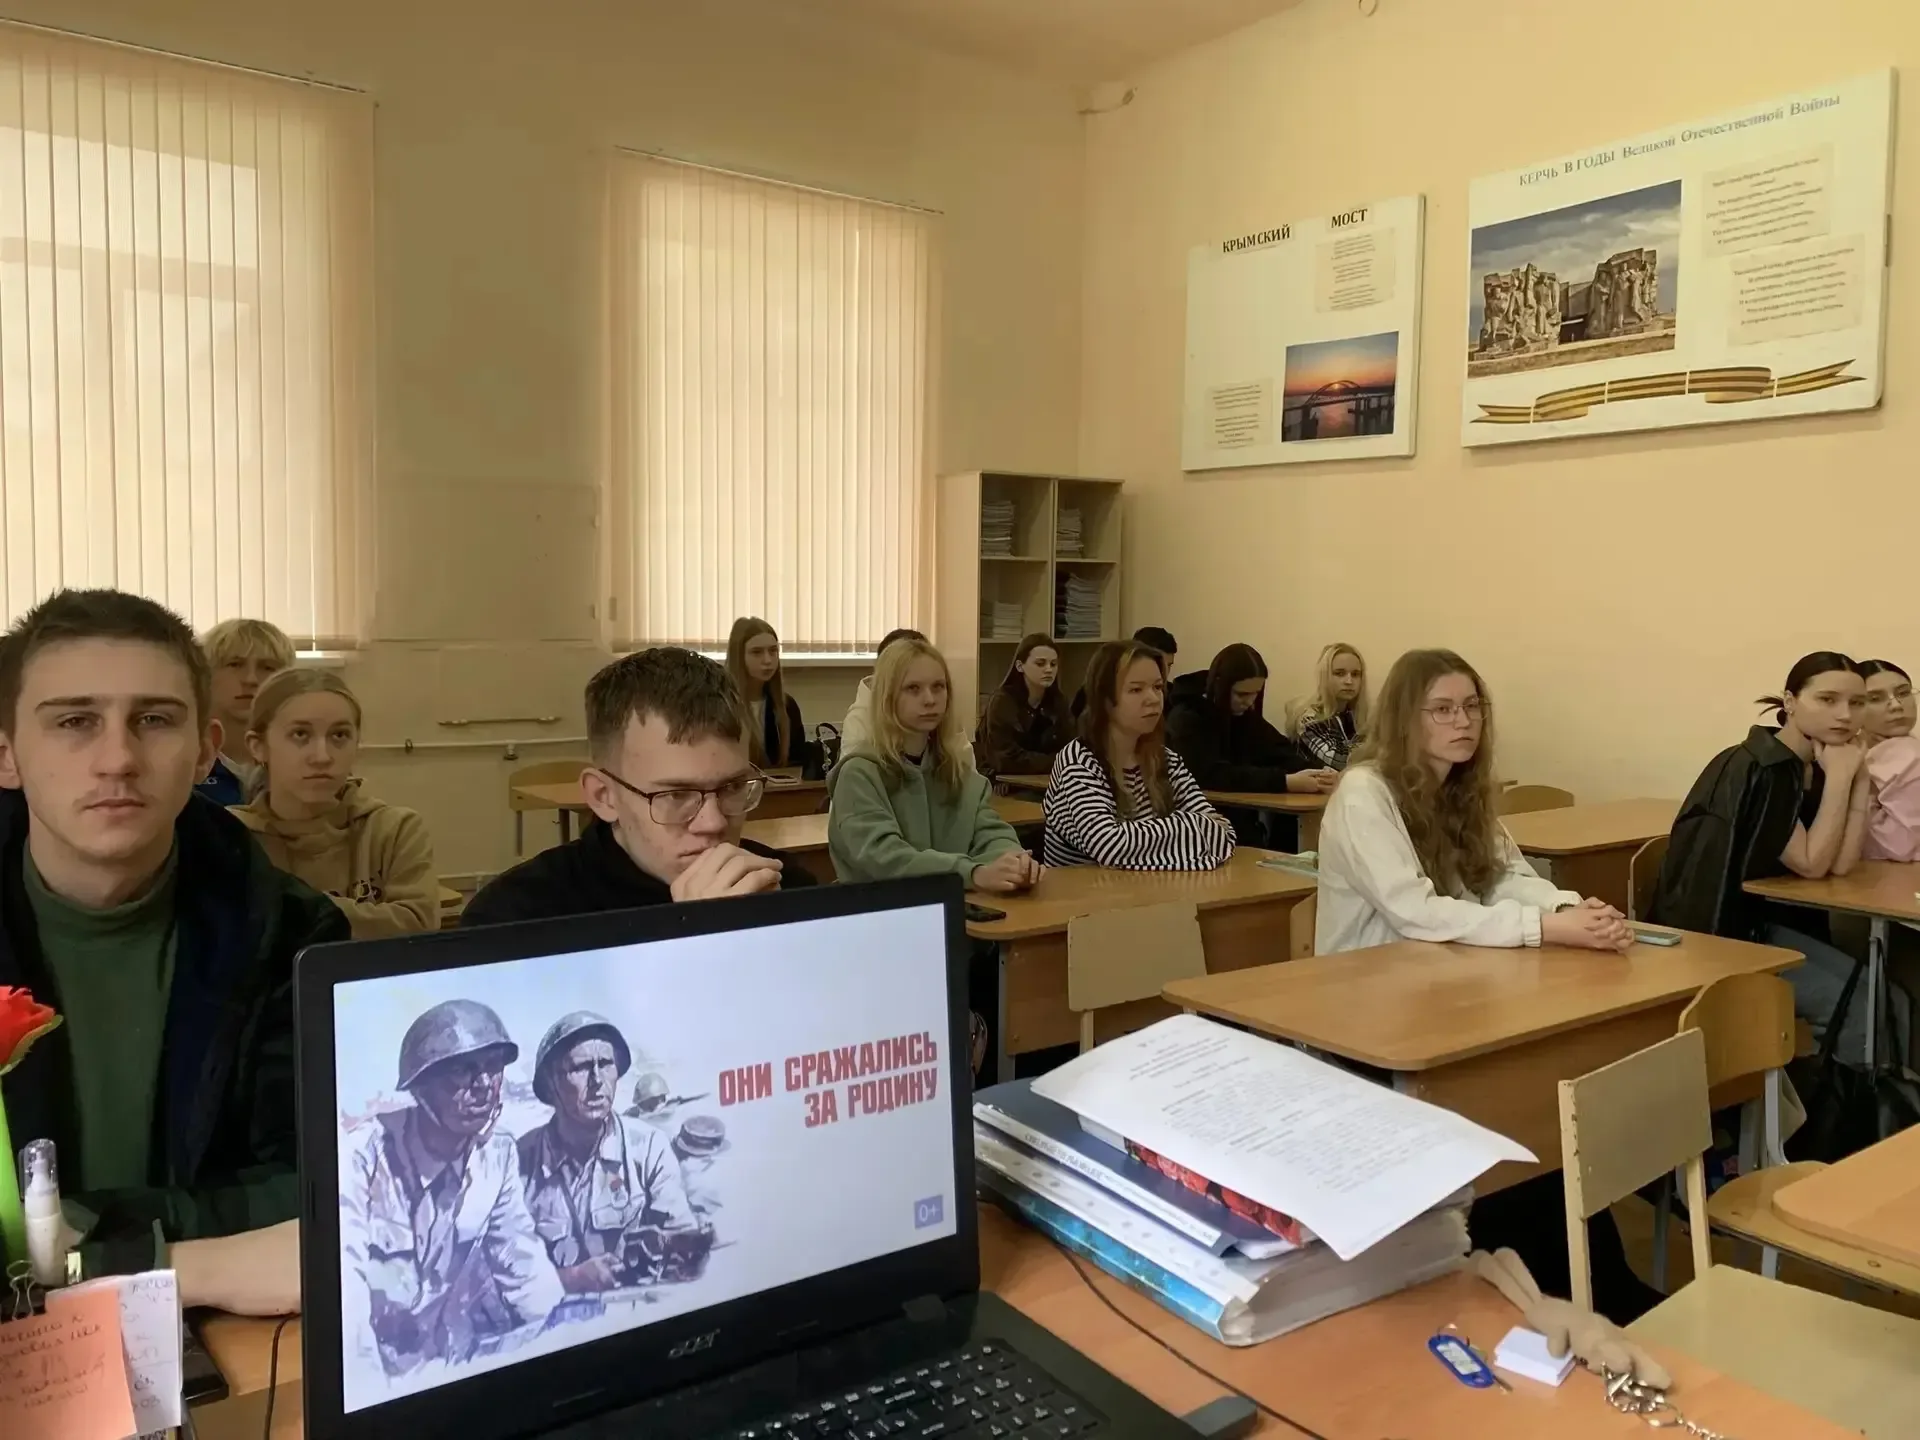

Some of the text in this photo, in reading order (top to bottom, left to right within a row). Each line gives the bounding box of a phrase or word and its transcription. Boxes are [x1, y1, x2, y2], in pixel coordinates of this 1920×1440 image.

[1519, 95, 1840, 186] КЕРЧЬ В ГОДЫ Великой Отечественной Войны
[1222, 208, 1368, 253] КРЫМСКИЙ МОСТ
[719, 1031, 938, 1107] ОНИ СРАЖАЛИСЬ
[805, 1067, 938, 1128] ЗА РОДИНУ
[918, 1203, 939, 1222] 0+
